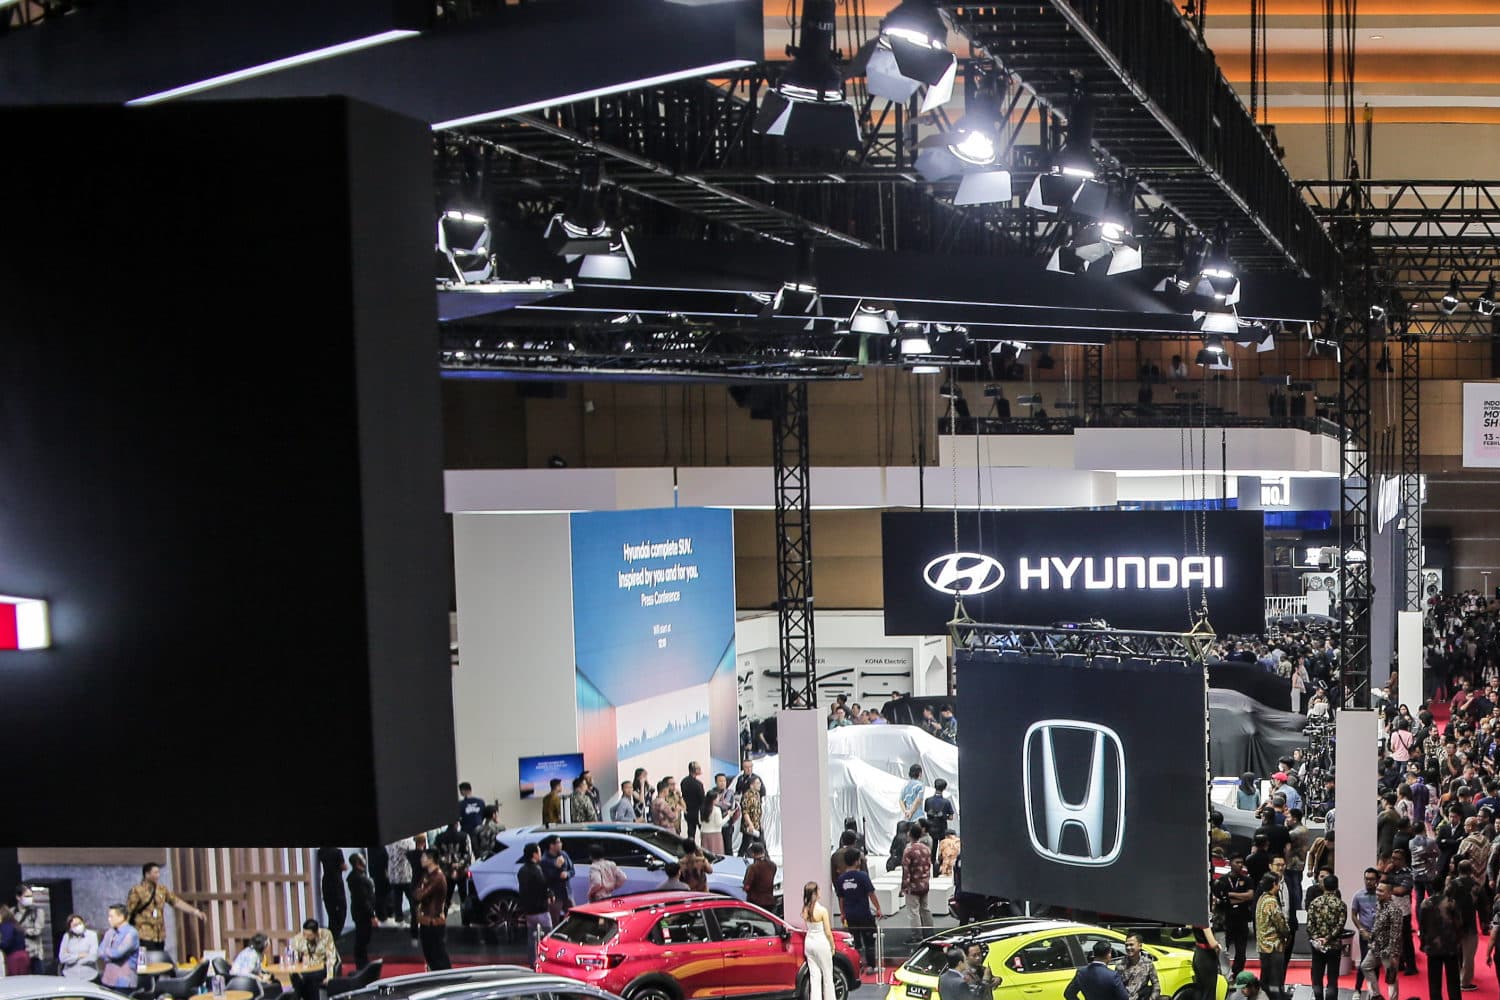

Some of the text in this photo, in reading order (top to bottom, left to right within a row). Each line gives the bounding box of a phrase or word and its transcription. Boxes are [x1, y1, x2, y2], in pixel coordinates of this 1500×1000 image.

[624, 538, 693, 564] Hyundai complete SUV.
[618, 563, 699, 591] Inspired by you and for you.
[1020, 556, 1223, 589] HYUNDAI
[641, 590, 680, 607] Press Conference
